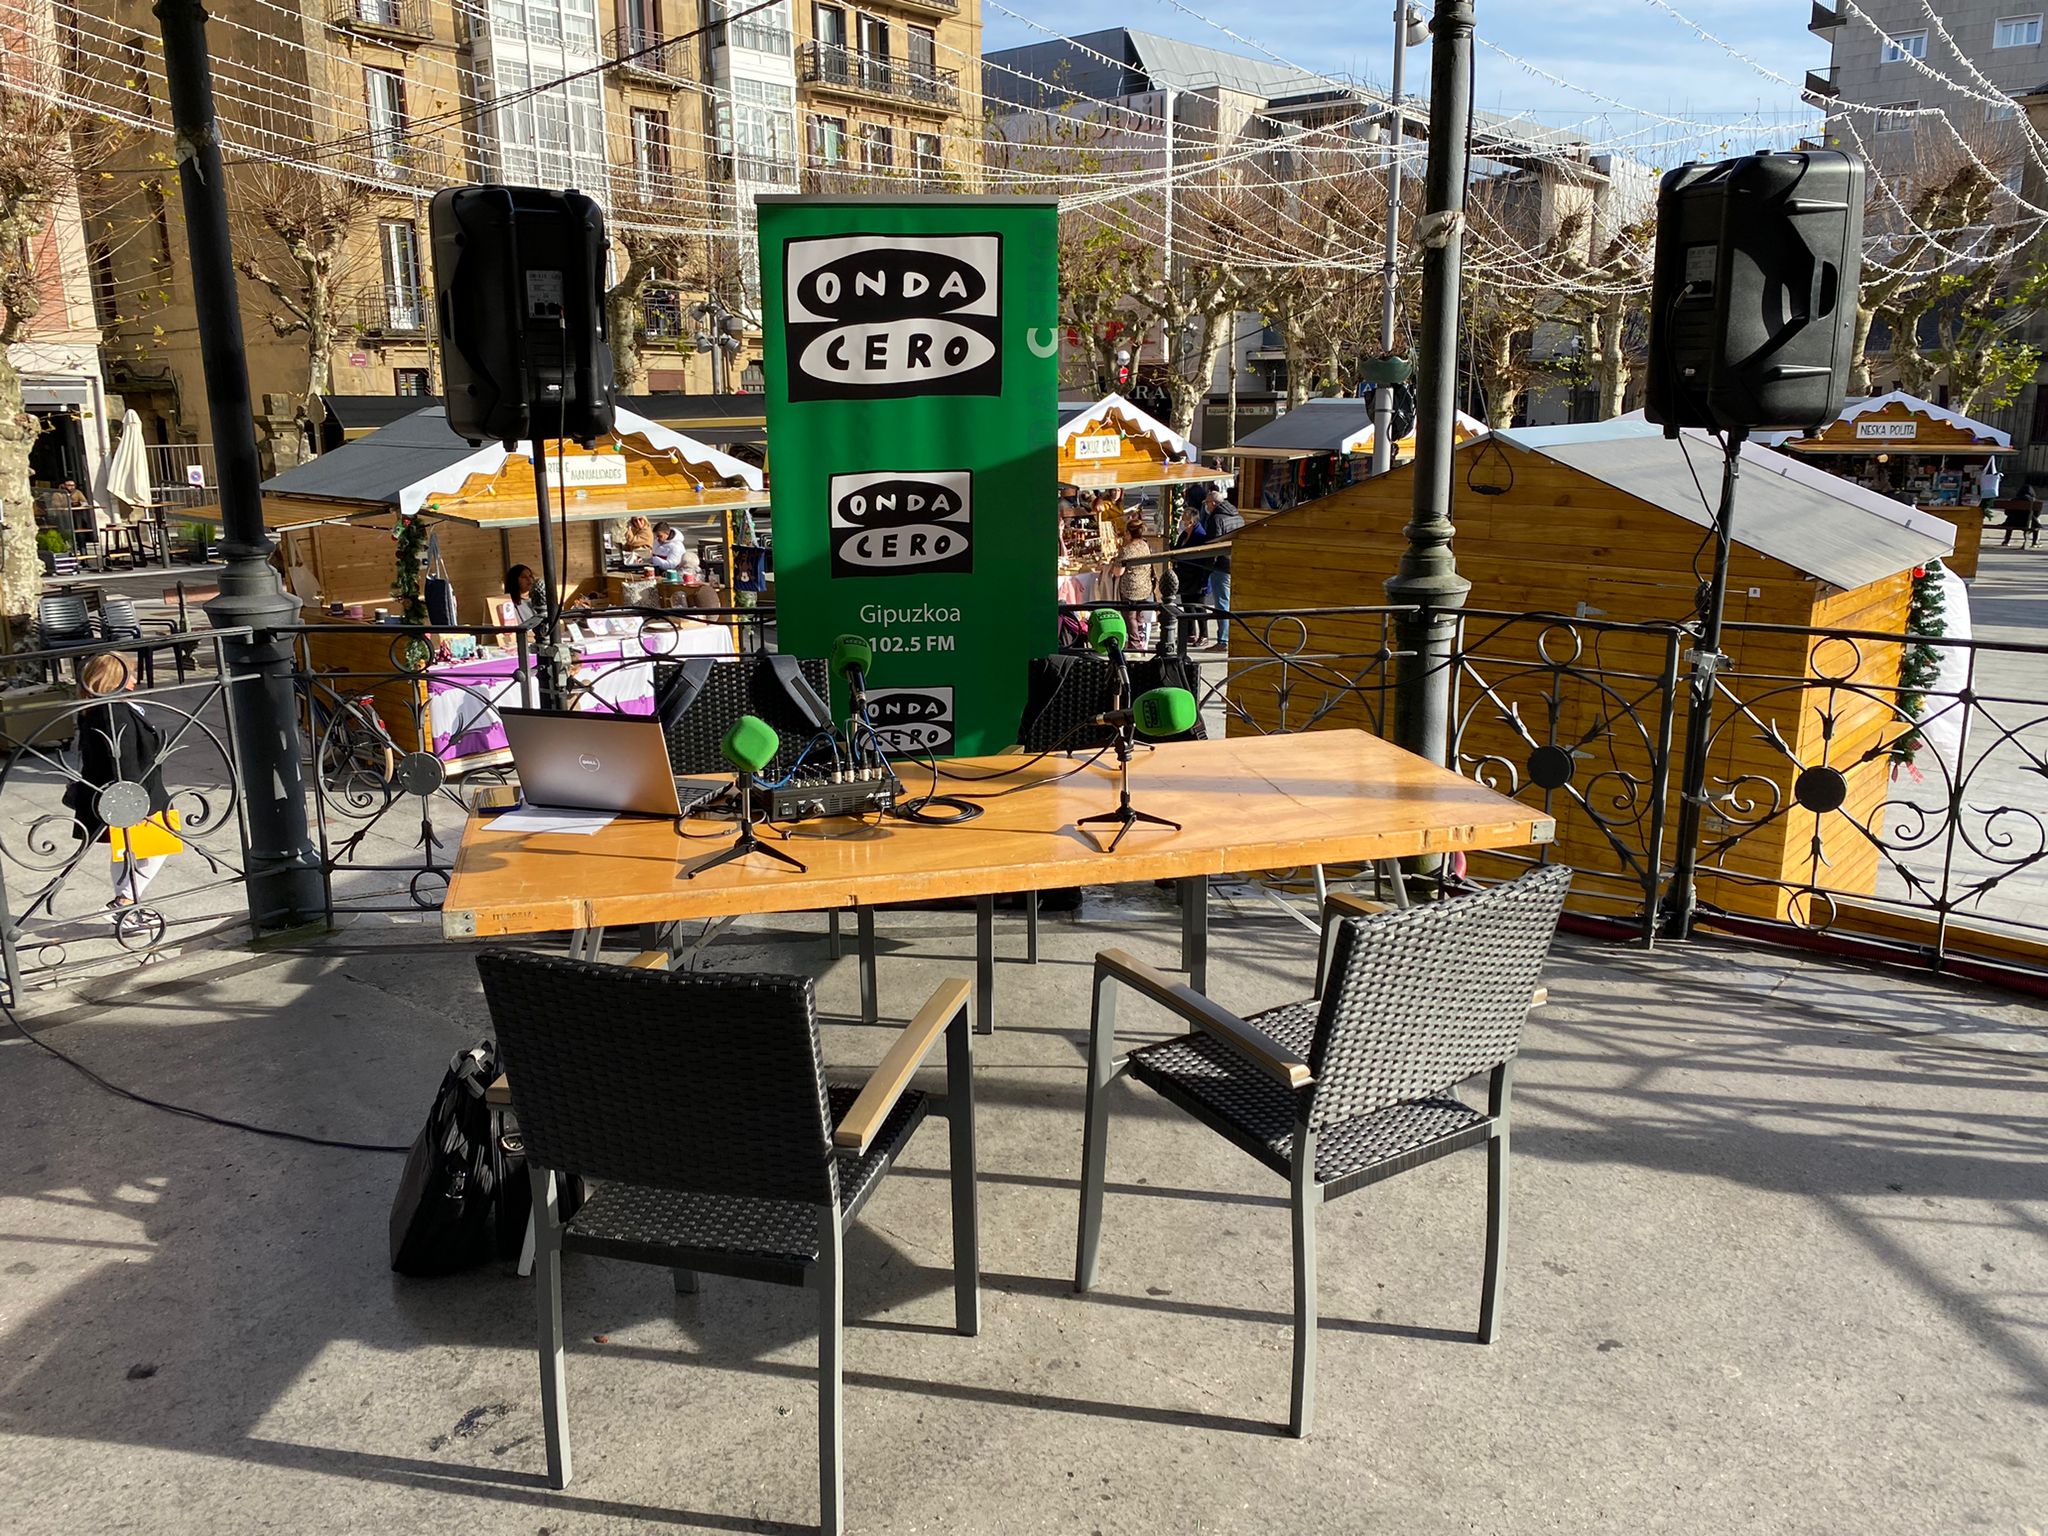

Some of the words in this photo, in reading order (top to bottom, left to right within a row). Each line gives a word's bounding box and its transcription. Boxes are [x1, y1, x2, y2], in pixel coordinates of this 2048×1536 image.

[815, 270, 968, 305] ONDA
[826, 332, 970, 371] CERO
[1861, 425, 1886, 435] NESKA
[1890, 425, 1914, 435] POLITA
[571, 469, 621, 480] MANUALIDADES
[849, 493, 951, 516] ONDA
[856, 533, 951, 558] CERO
[860, 602, 961, 628] Gipuzkoa
[868, 636, 921, 652] 102.5
[926, 635, 955, 652] FM
[867, 702, 939, 718] ONDA
